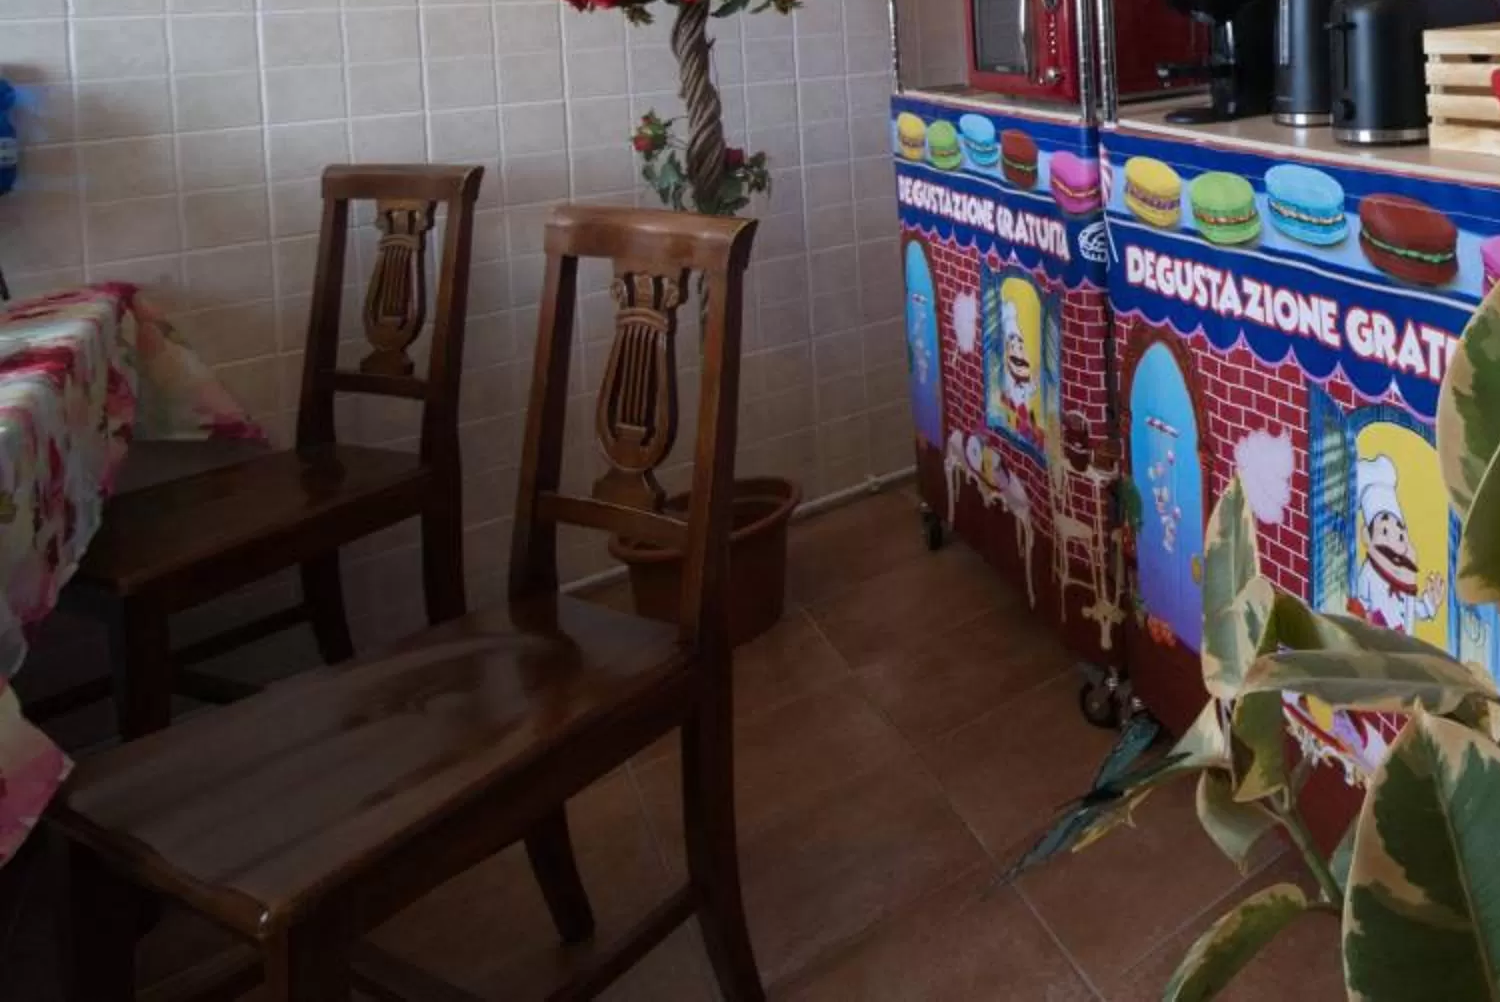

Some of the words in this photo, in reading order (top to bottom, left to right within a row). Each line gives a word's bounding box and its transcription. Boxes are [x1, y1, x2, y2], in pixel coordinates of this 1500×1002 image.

[898, 175, 995, 233] DEGUSTAZIONE
[1125, 246, 1342, 349] DEGUSTAZIONE
[1344, 306, 1461, 382] GRAT
